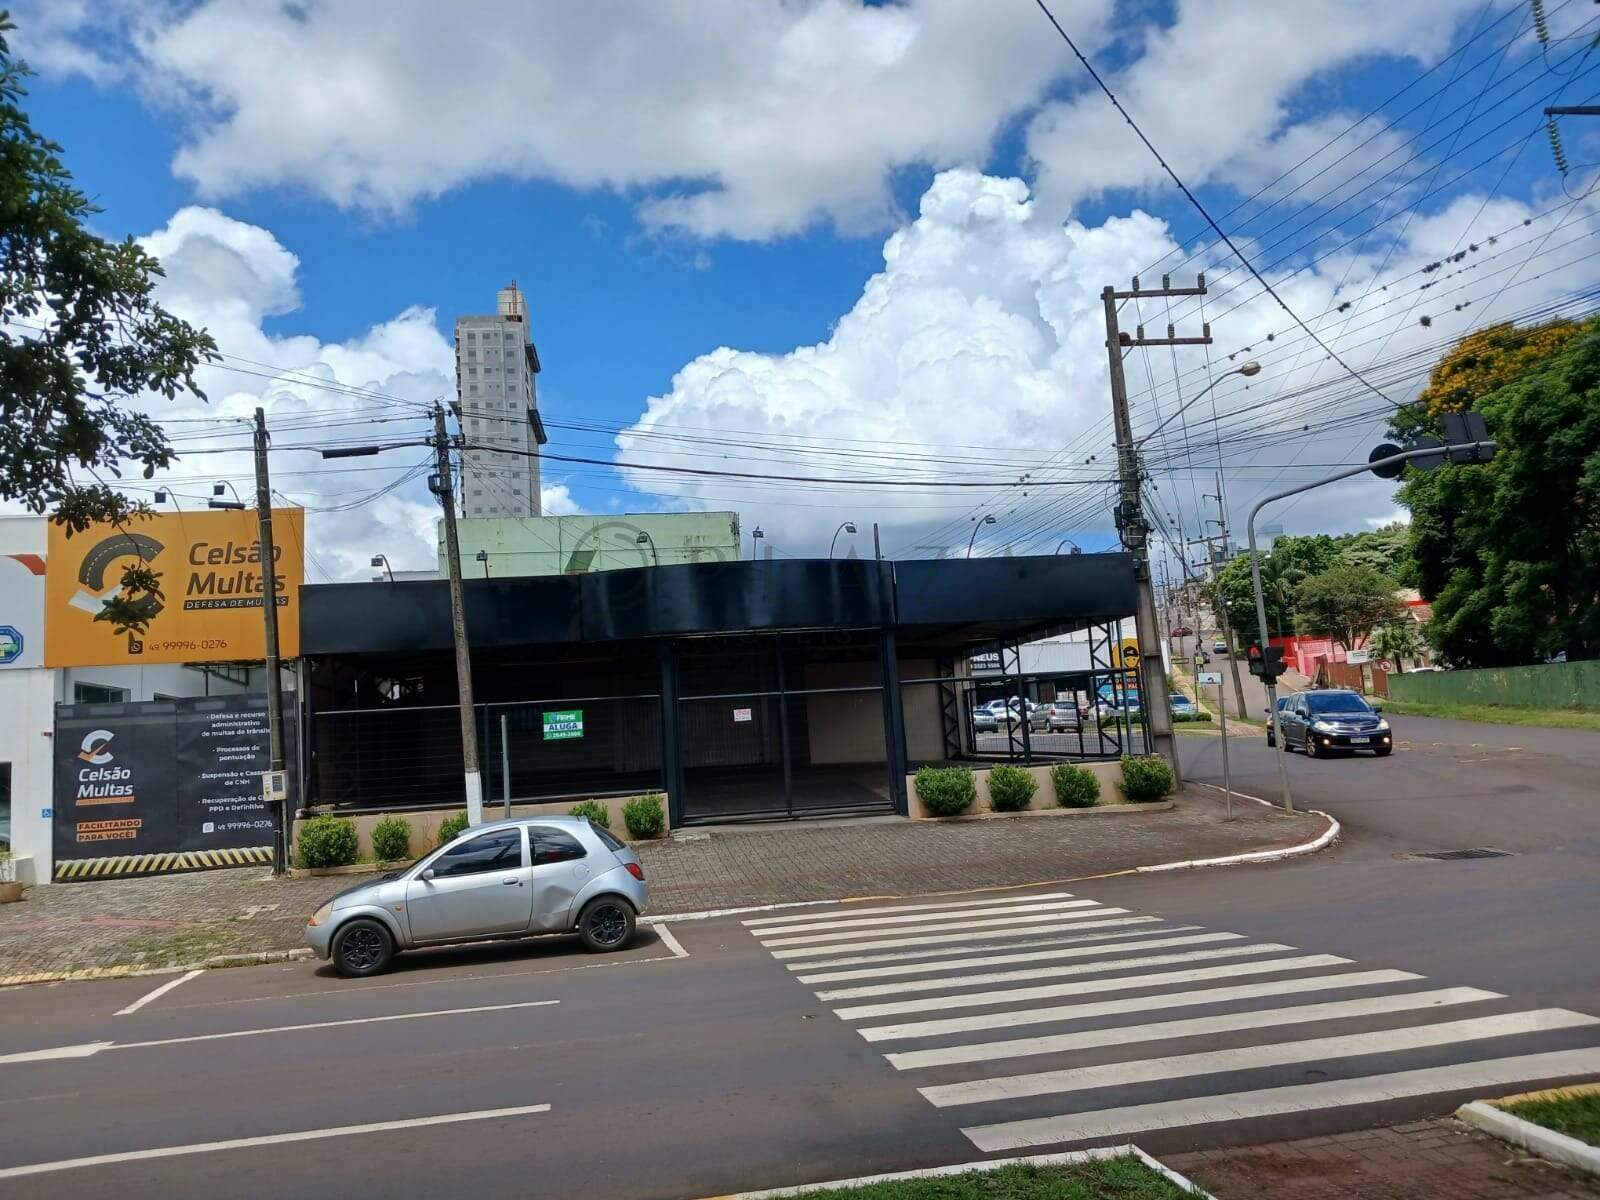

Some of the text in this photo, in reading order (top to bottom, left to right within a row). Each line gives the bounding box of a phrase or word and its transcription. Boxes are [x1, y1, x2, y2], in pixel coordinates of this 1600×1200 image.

[186, 600, 227, 609] DEFESA
[230, 599, 244, 608] DE
[162, 639, 228, 650] 99996-0276
[240, 711, 266, 719] recurso
[211, 719, 261, 728] administrativo
[549, 722, 578, 731] ALUGA
[211, 729, 235, 737] multas
[218, 753, 256, 762] pontuação
[79, 766, 131, 782] Celsão
[201, 771, 239, 779] Suspensão
[77, 783, 134, 799] Multas
[201, 796, 247, 805] Recuperação
[78, 819, 140, 830] FACILITANDO
[227, 820, 273, 830] 99996-0276
[78, 833, 103, 841] PARA
